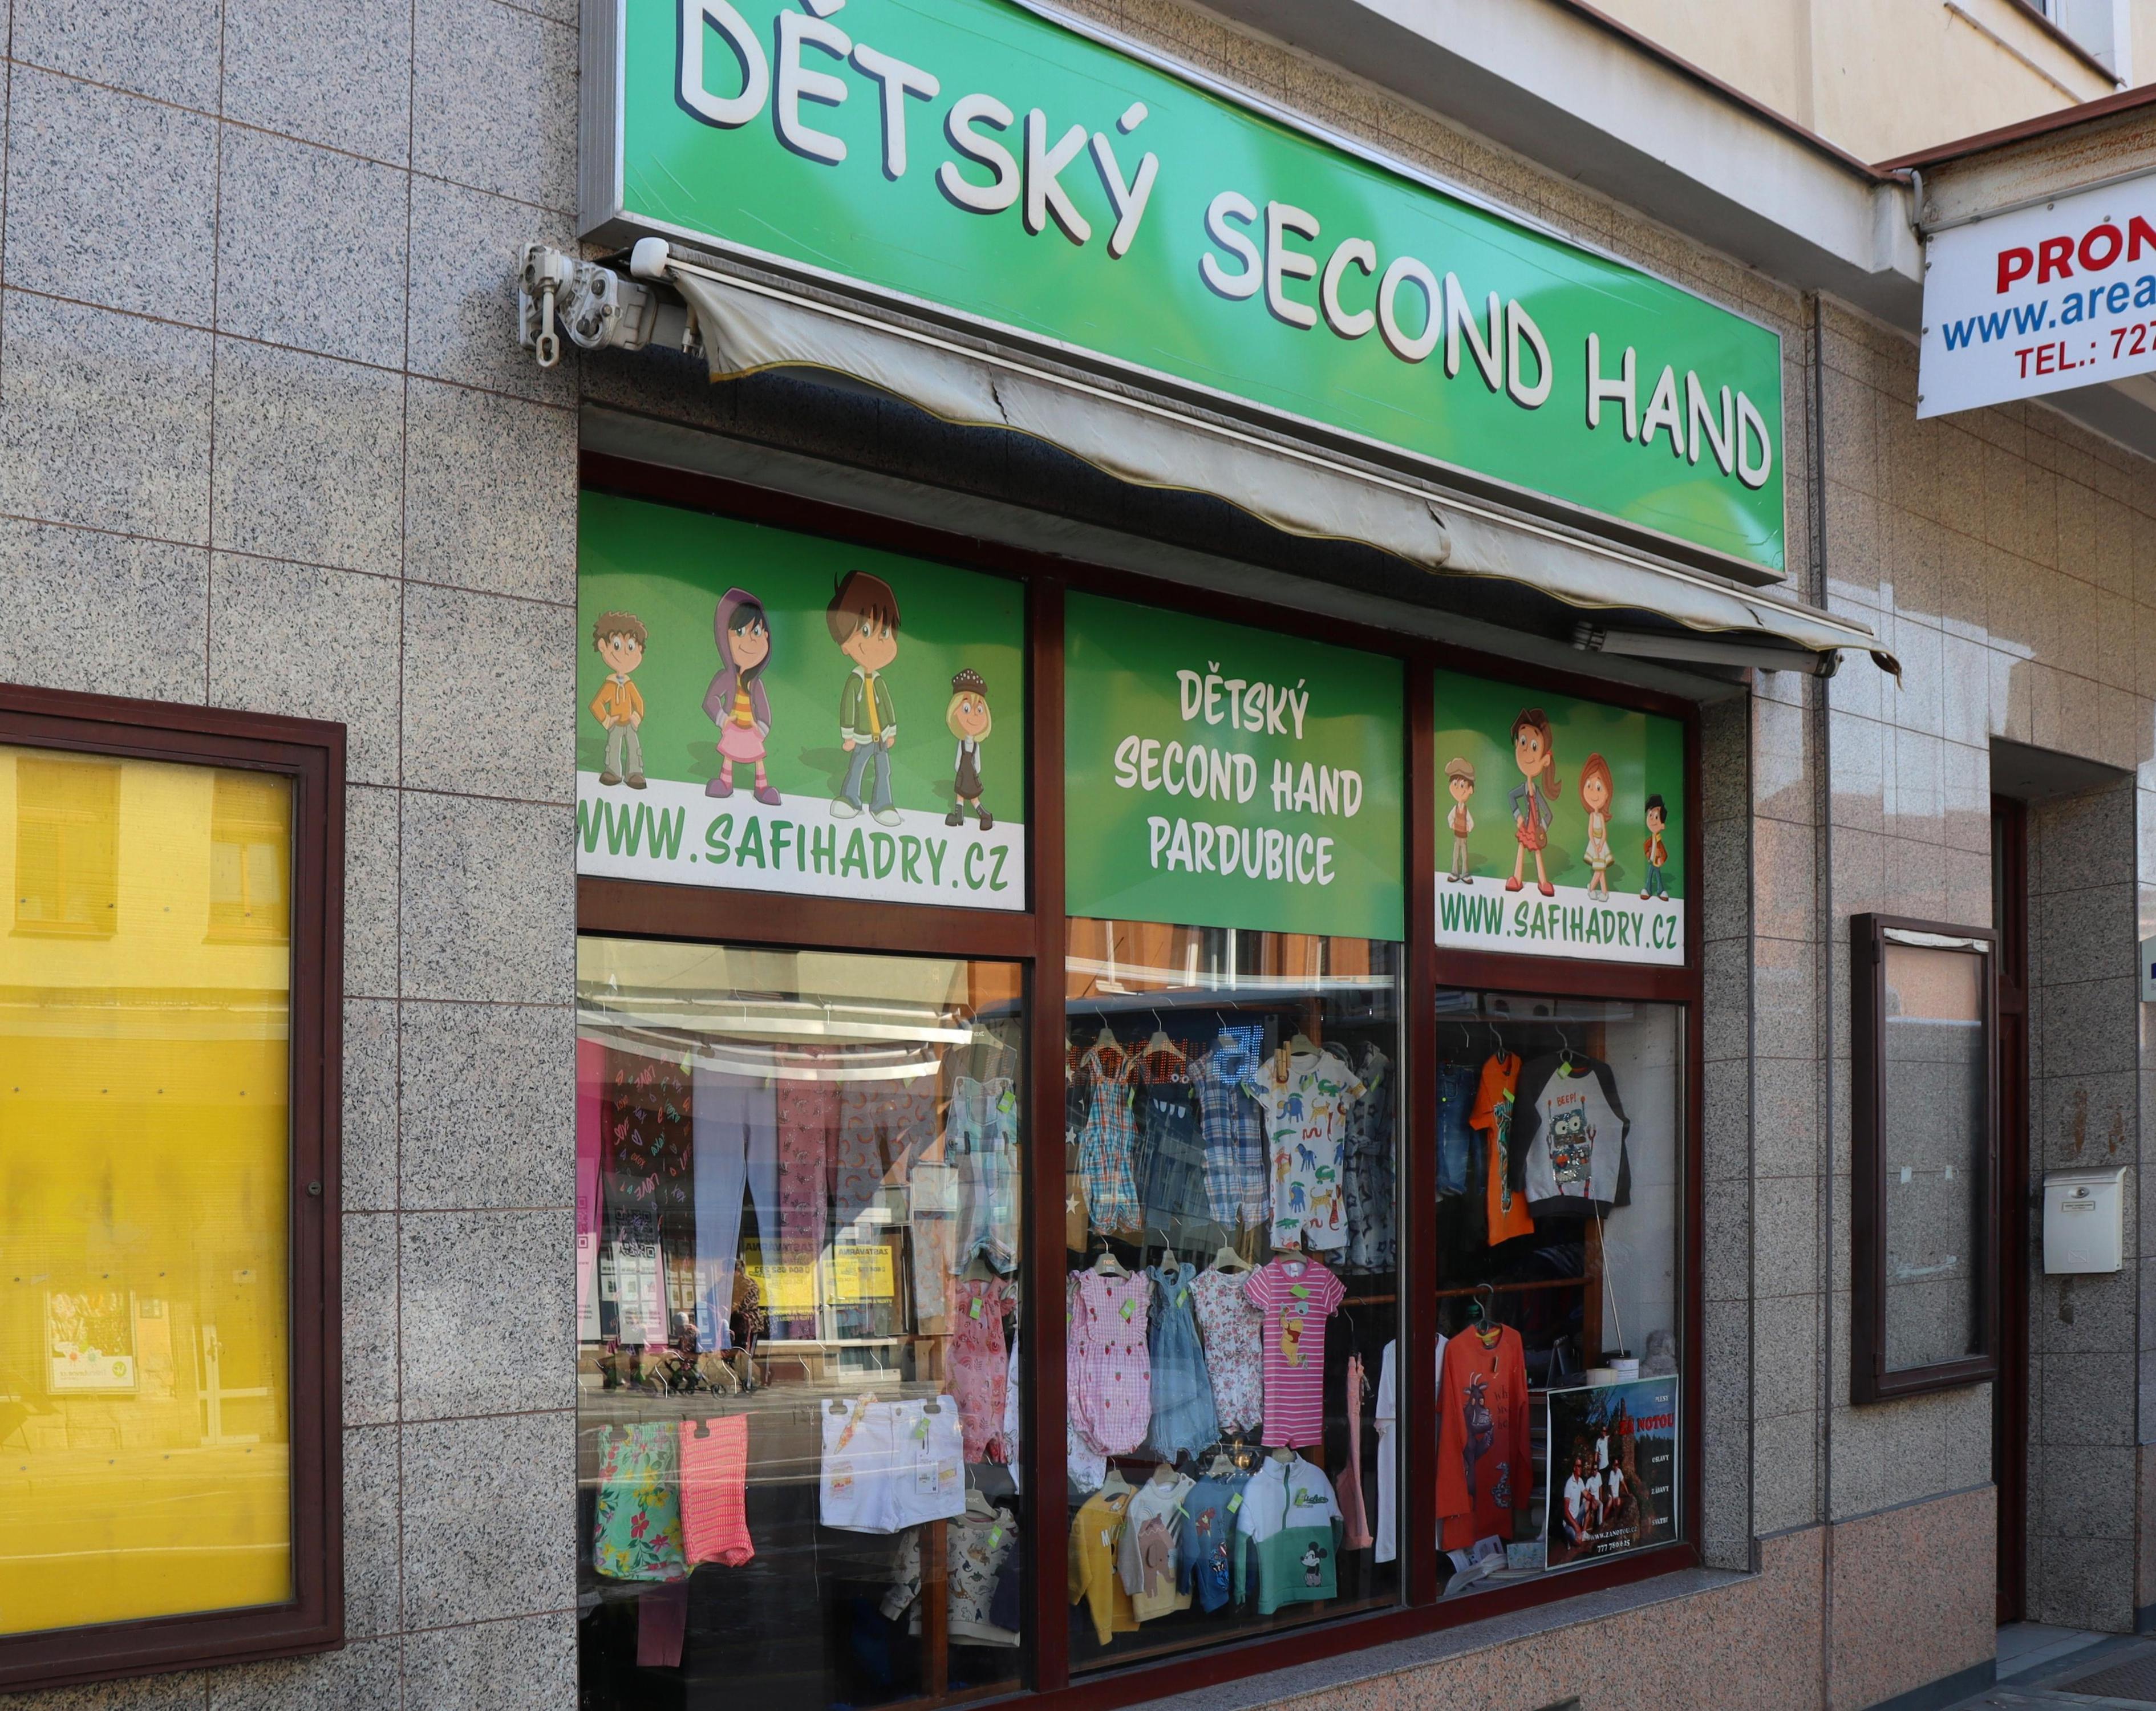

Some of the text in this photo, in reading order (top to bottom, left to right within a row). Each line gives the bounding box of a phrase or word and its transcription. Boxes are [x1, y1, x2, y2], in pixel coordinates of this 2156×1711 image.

[675, 0, 1772, 490] DĚTSKÝ SECOND HAND
[1942, 275, 2156, 351] www.area
[2015, 340, 2097, 379] TEL.:
[1176, 660, 1309, 739] DĚTSKÝ
[1115, 735, 1363, 817] SECOND HAND
[577, 797, 1009, 891] WWW.SAFIHADRY.CZ
[1148, 816, 1335, 885] PARDUBICE
[1440, 891, 1677, 949] WWW.SAFIHADRY.CZ
[1557, 1092, 1577, 1106] BEEP!
[1619, 1413, 1675, 1436] ZA NOTOU
[1651, 1454, 1669, 1463] OSLAVY
[1597, 1543, 1608, 1553] 777
